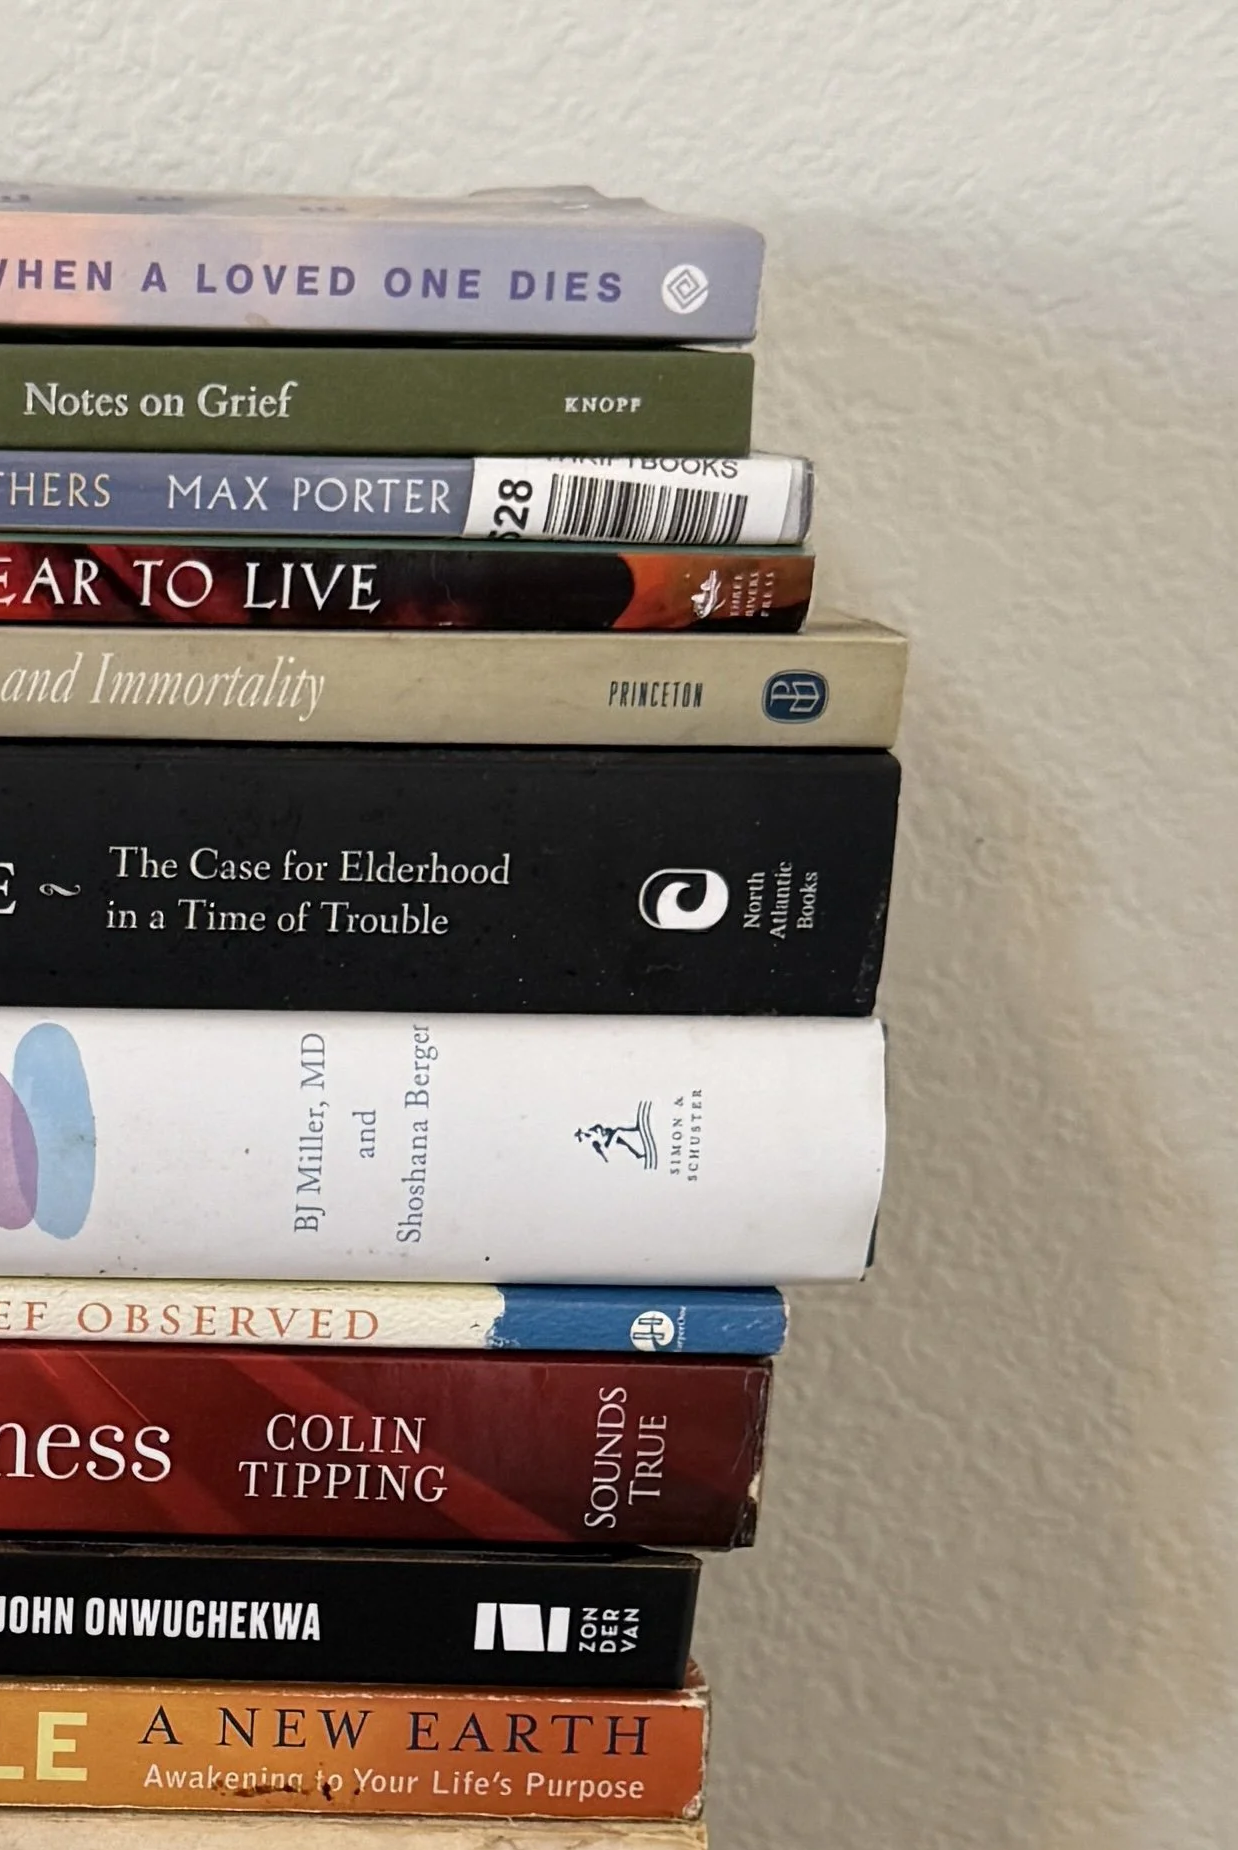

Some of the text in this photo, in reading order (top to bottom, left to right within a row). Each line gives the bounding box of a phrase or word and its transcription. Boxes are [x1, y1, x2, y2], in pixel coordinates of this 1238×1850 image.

[142, 262, 167, 293] A
[197, 264, 355, 297] LOVED
[385, 267, 481, 299] ONE
[511, 271, 622, 303] DIES
[24, 382, 298, 420] Notes on Grief
[565, 396, 642, 413] KNOPF
[168, 475, 449, 513] MAX PORTER
[1, 653, 83, 704] and
[90, 651, 324, 721] Immortality
[609, 680, 702, 708] PRINCETON
[109, 846, 511, 887] The Case for Elderhood
[106, 898, 449, 936] in a Time of Trouble
[743, 871, 765, 929] North
[768, 861, 793, 939] Atlantic
[796, 870, 819, 930] Books
[294, 1033, 329, 1232] BJ Miller, MD
[352, 1108, 376, 1159] and
[396, 1023, 439, 1244] Shoshana Berger
[670, 1117, 683, 1175] SIMON
[688, 1089, 702, 1182] SCHUSTER
[266, 1412, 426, 1455] COLIN
[584, 1385, 627, 1529] SOUNDS
[629, 1413, 667, 1506] TRUE
[238, 1461, 449, 1503] TIPPING
[84, 1597, 321, 1641] ONWUCHEKWA
[579, 1606, 596, 1652] ZON
[600, 1607, 620, 1652] DER
[622, 1607, 641, 1653] VAN
[315, 1769, 342, 1792] to
[354, 1768, 418, 1793] Your
[433, 1770, 511, 1795] Life's
[526, 1773, 644, 1802] Purpose
